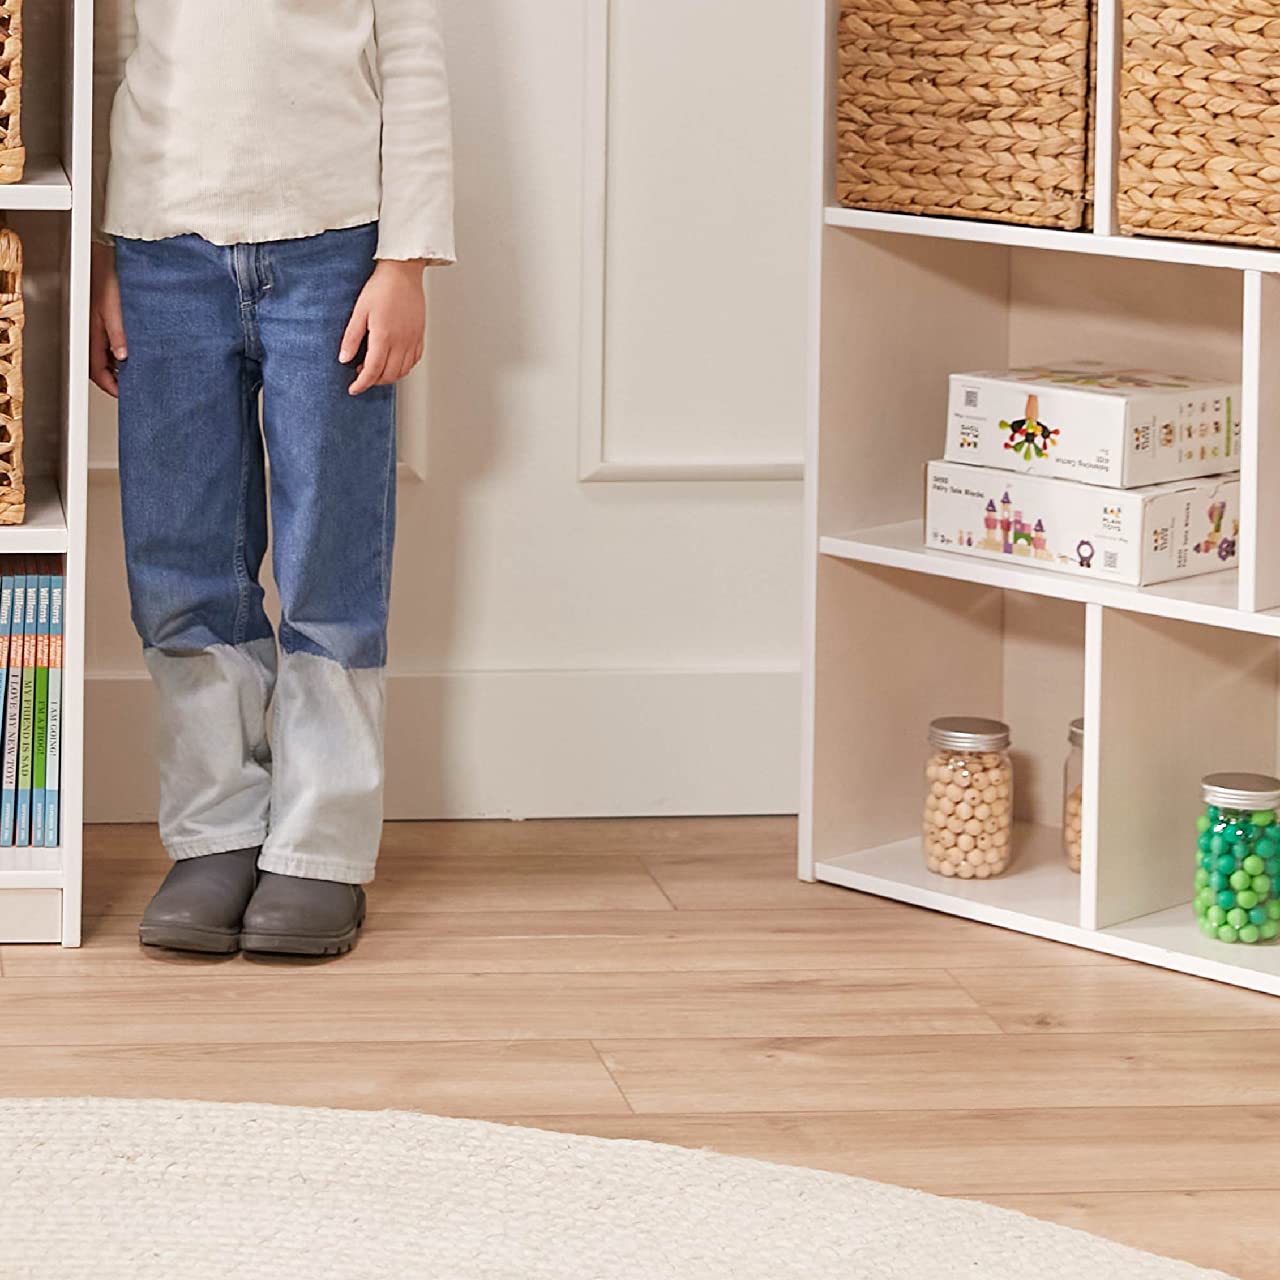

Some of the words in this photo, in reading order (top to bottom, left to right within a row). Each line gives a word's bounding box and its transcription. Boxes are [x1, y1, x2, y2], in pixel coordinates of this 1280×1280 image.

[51, 588, 62, 623] Willems
[8, 681, 18, 708] LOVE
[22, 699, 31, 739] FRIEND
[6, 731, 16, 756] NEW
[5, 759, 15, 784] TOY!
[20, 755, 29, 776] SAD
